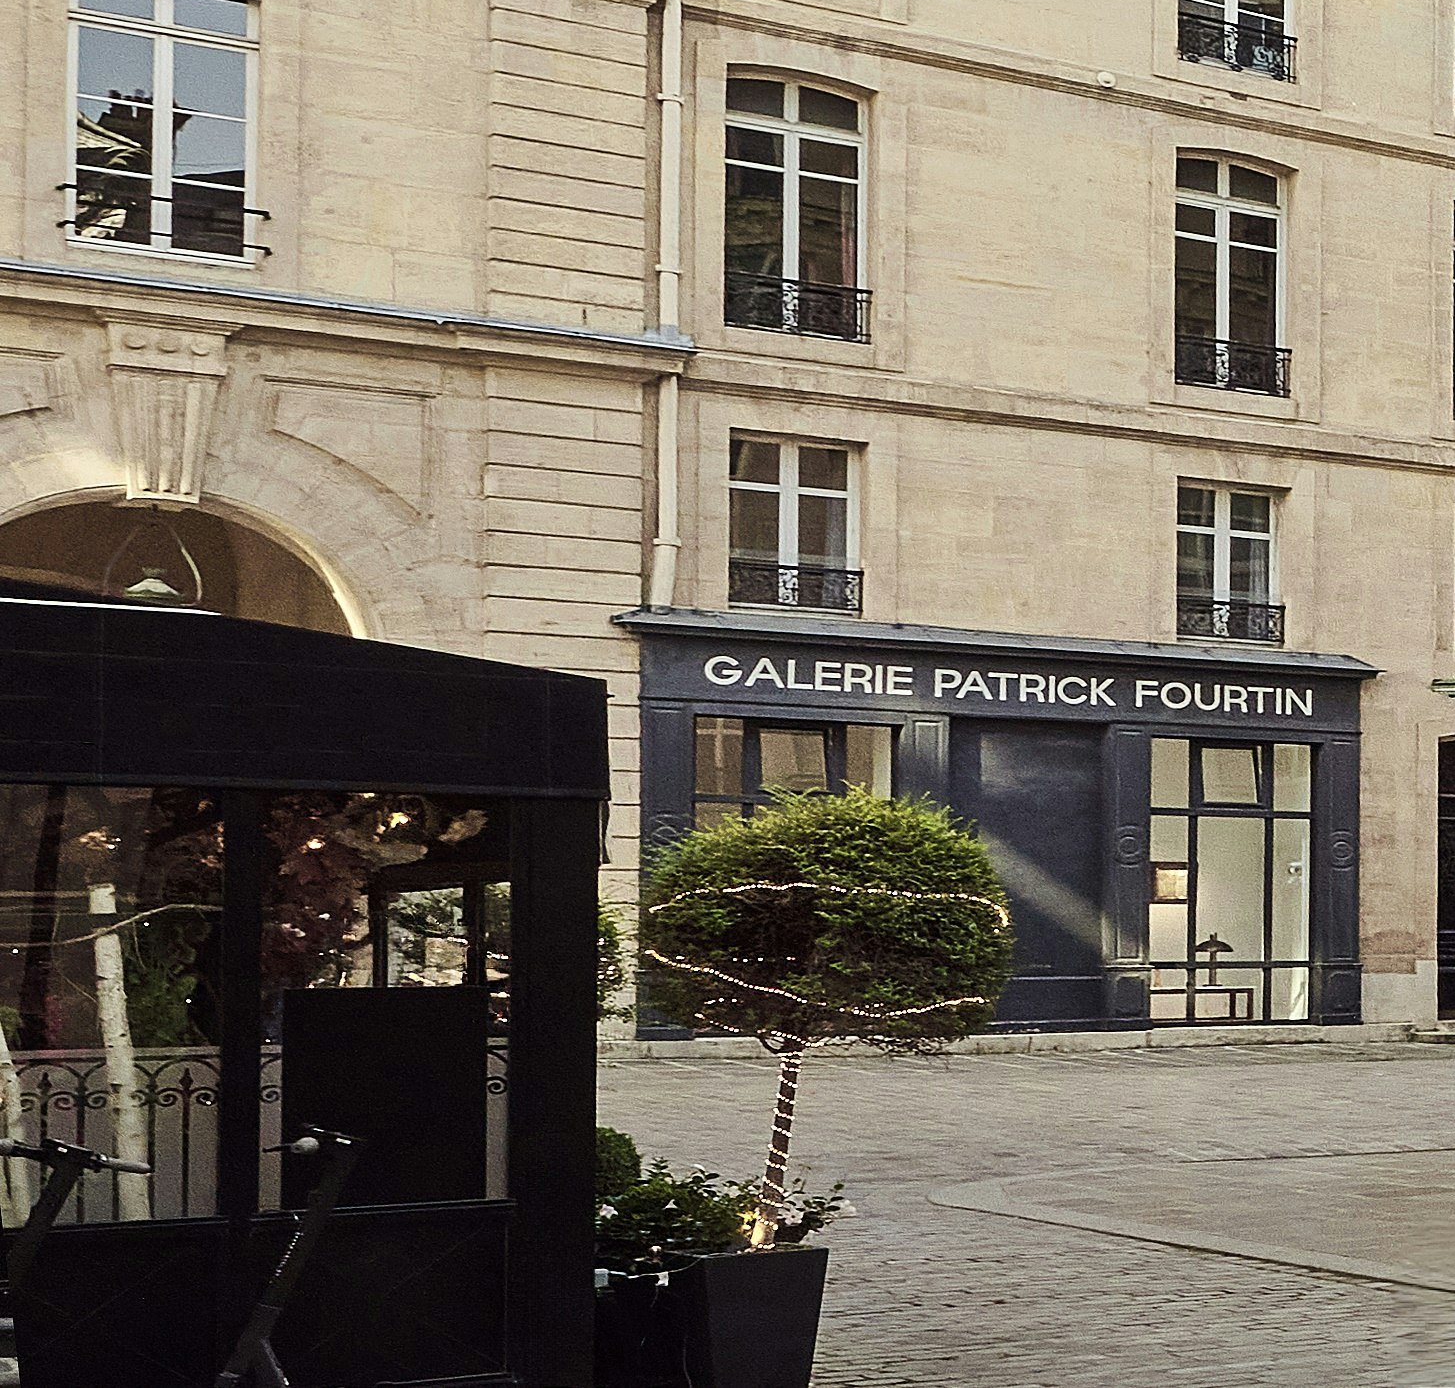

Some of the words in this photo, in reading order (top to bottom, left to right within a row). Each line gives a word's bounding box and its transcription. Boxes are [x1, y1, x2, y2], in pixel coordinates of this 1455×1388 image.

[704, 656, 913, 696] GALERIE
[934, 668, 1117, 708] PATRICK
[1134, 680, 1314, 717] FOURTIN
